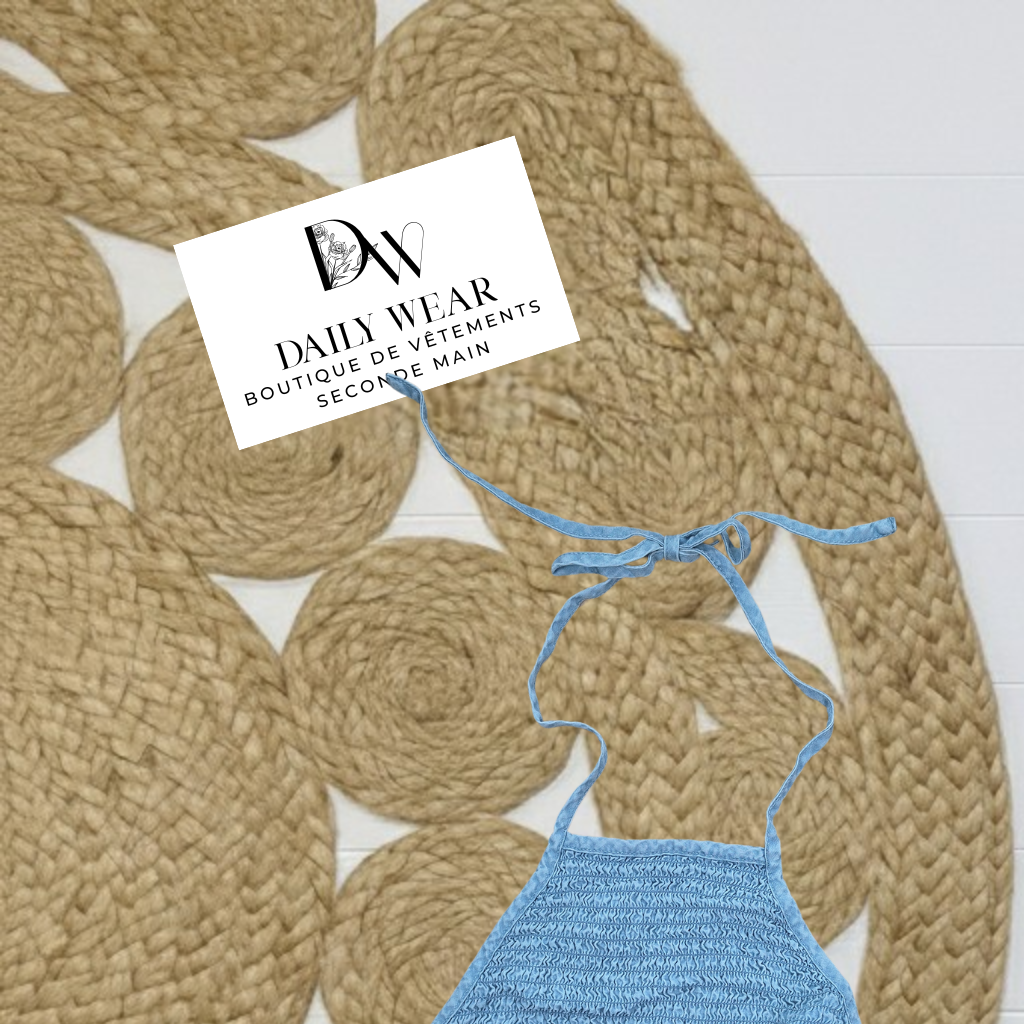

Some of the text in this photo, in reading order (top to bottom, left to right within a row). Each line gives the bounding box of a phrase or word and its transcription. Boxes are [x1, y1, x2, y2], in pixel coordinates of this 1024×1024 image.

[244, 299, 541, 407] BOUTIQUE DE VÊTEMENTS
[274, 276, 499, 371] DAILY WEAR
[433, 341, 490, 371] MAIN
